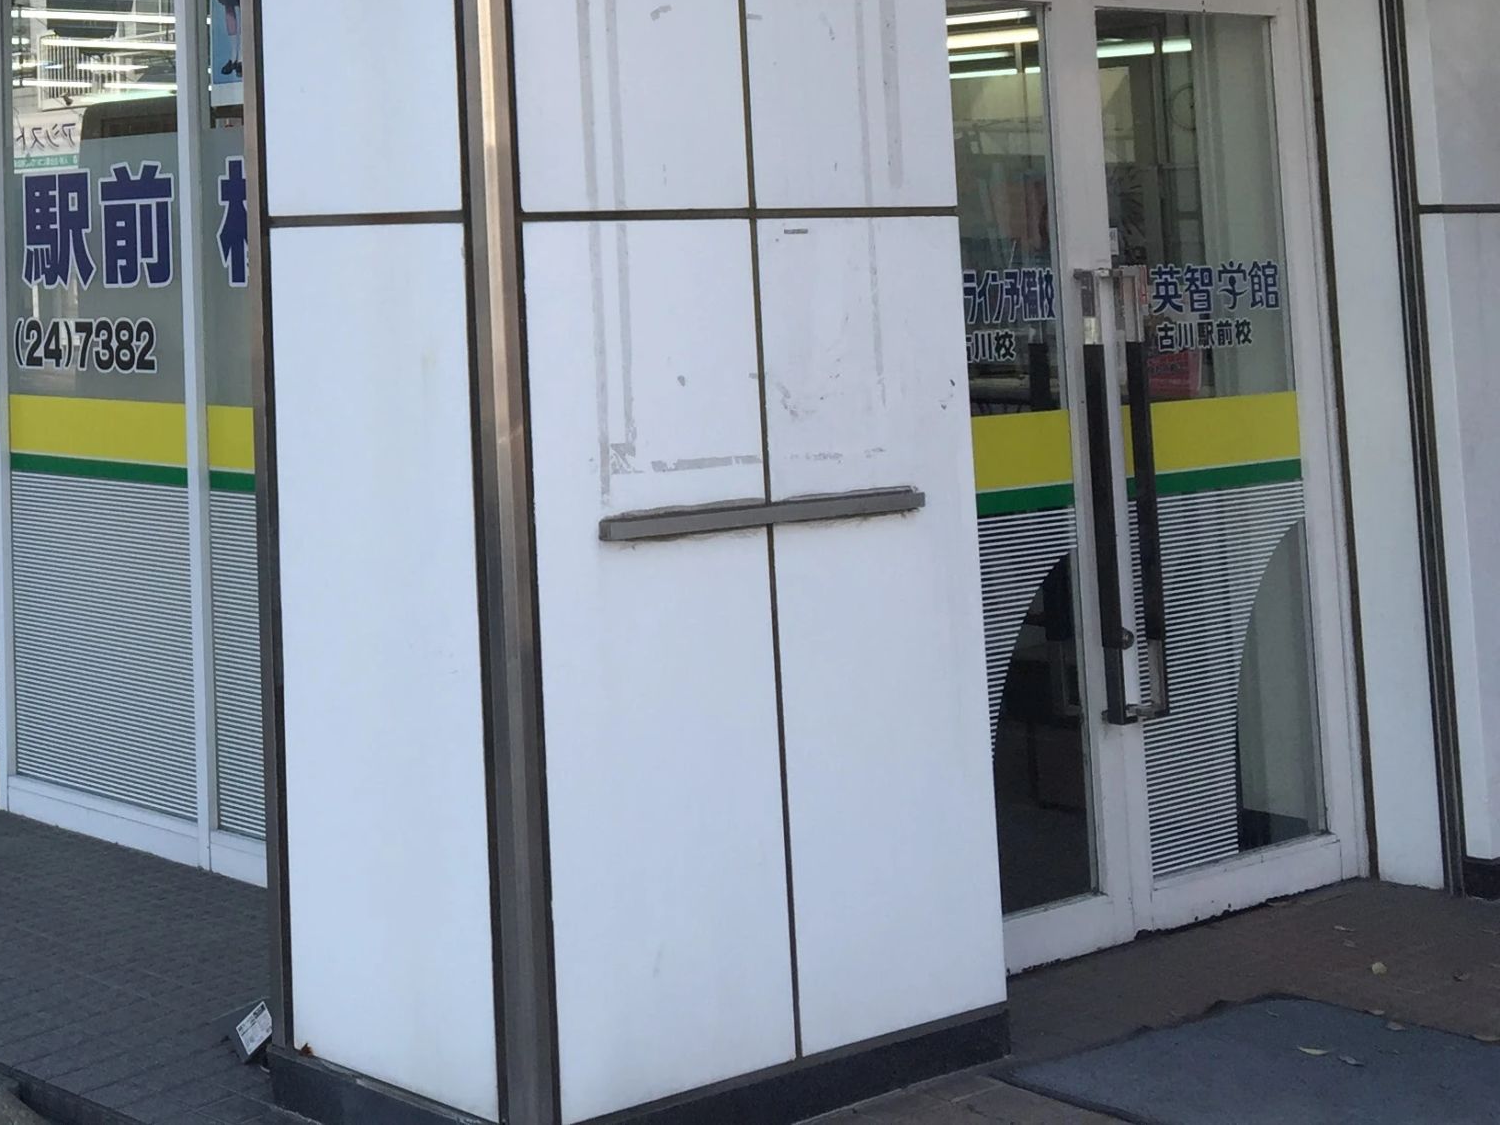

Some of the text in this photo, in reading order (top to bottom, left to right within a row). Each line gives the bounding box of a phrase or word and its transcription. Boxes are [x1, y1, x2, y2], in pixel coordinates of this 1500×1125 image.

[1151, 260, 1279, 313] 英智学館
[1157, 316, 1252, 352] 古川駅前校
